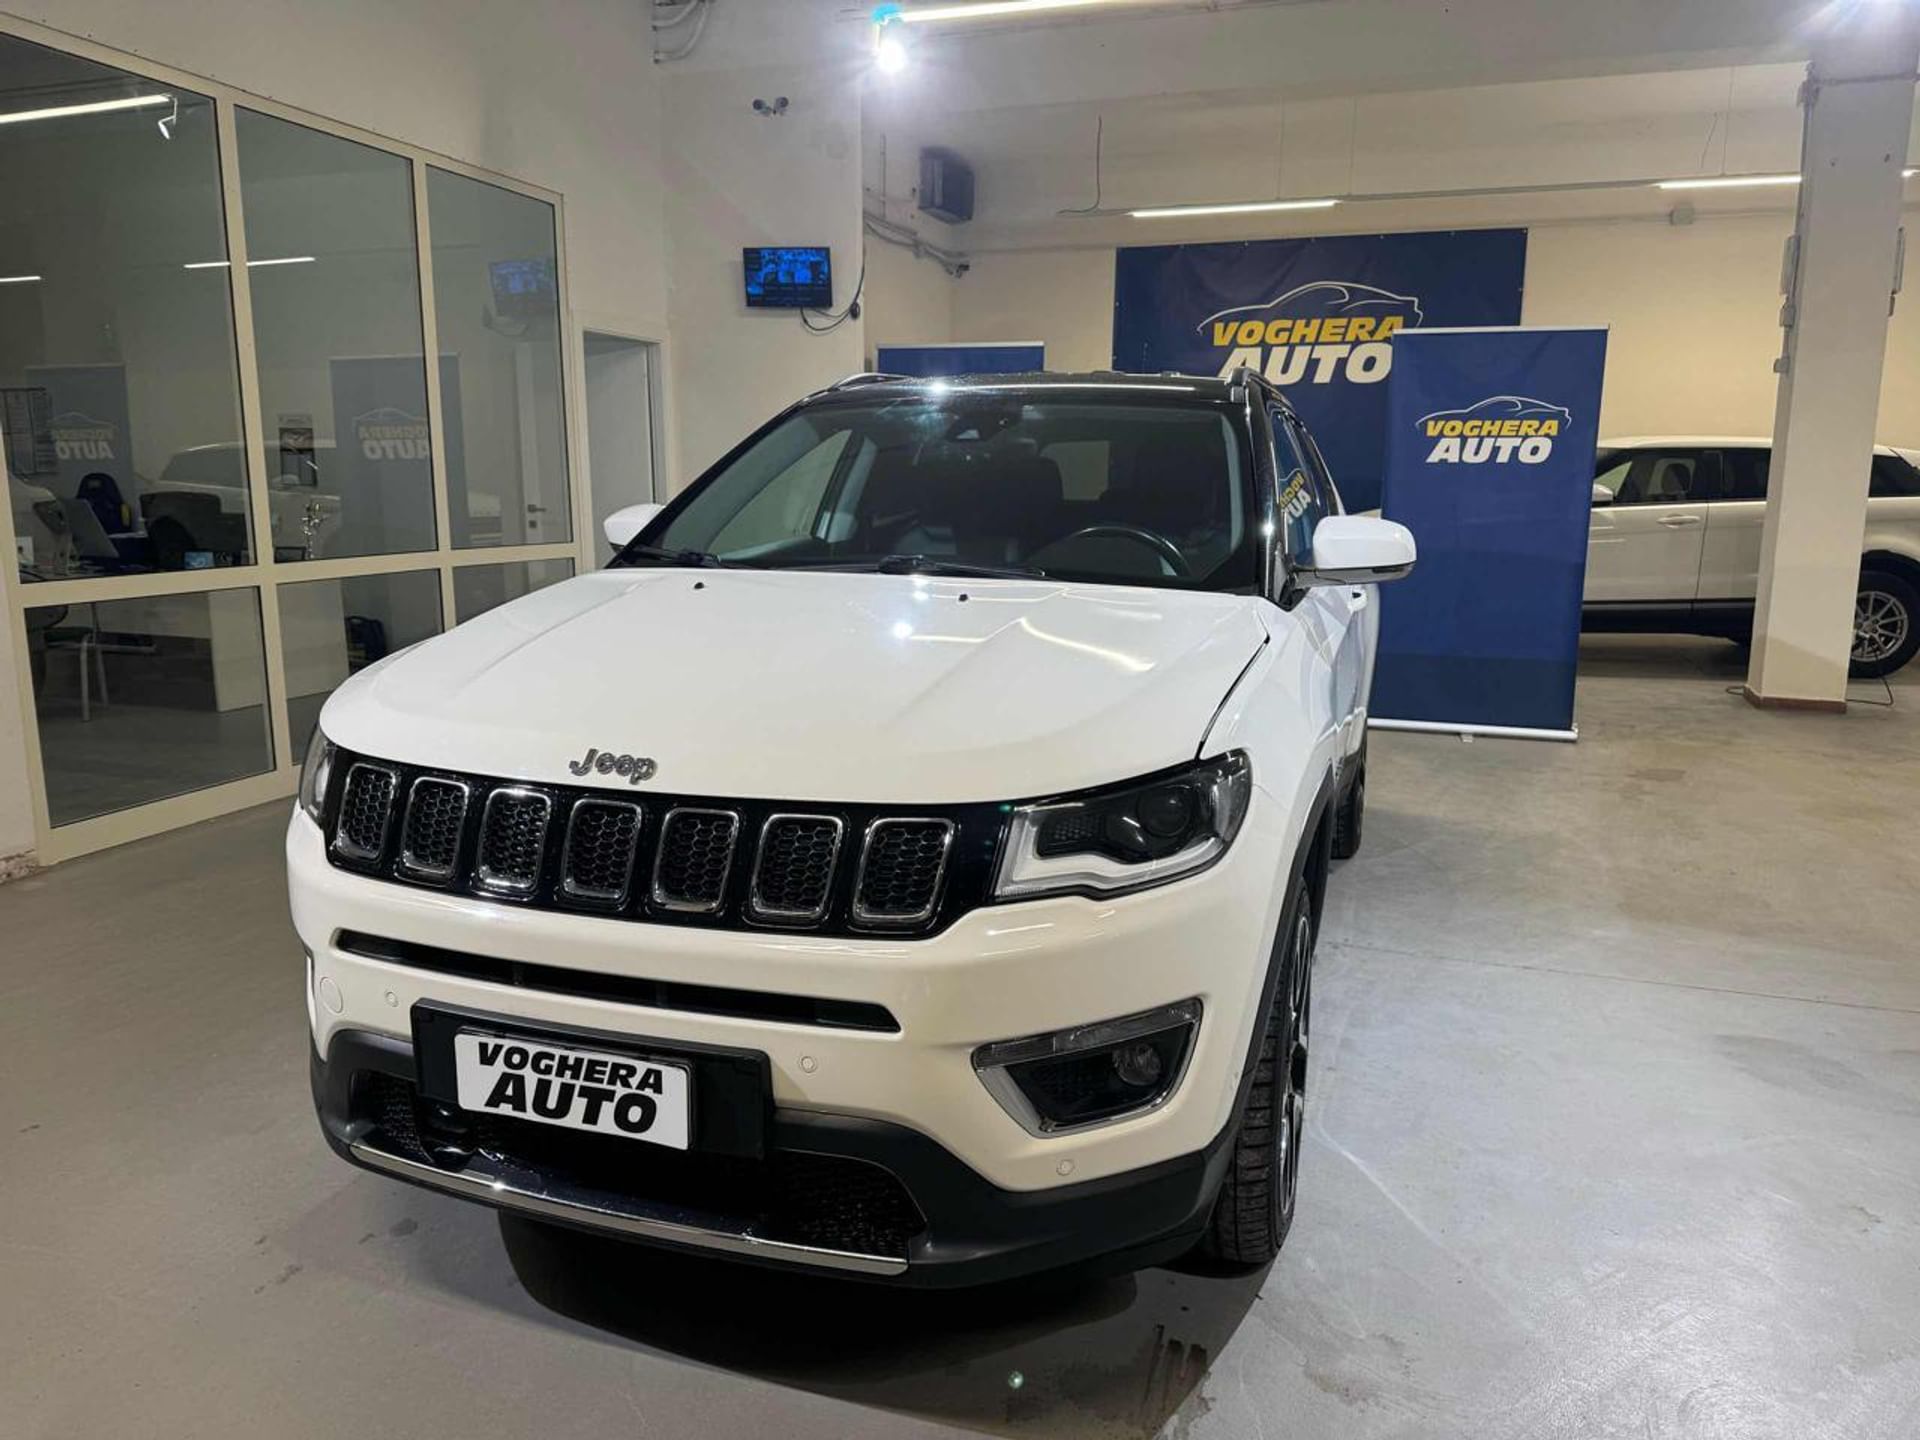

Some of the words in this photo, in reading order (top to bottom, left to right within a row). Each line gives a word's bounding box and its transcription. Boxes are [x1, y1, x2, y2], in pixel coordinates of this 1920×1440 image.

[1213, 316, 1404, 346] VOGHERA
[1217, 342, 1393, 386] AUTO
[1426, 419, 1560, 437] VOGHERA
[1425, 436, 1553, 464] AUTO
[568, 748, 659, 785] Jeep
[478, 1040, 664, 1095] VOGHERA
[484, 1072, 658, 1134] AUTO
